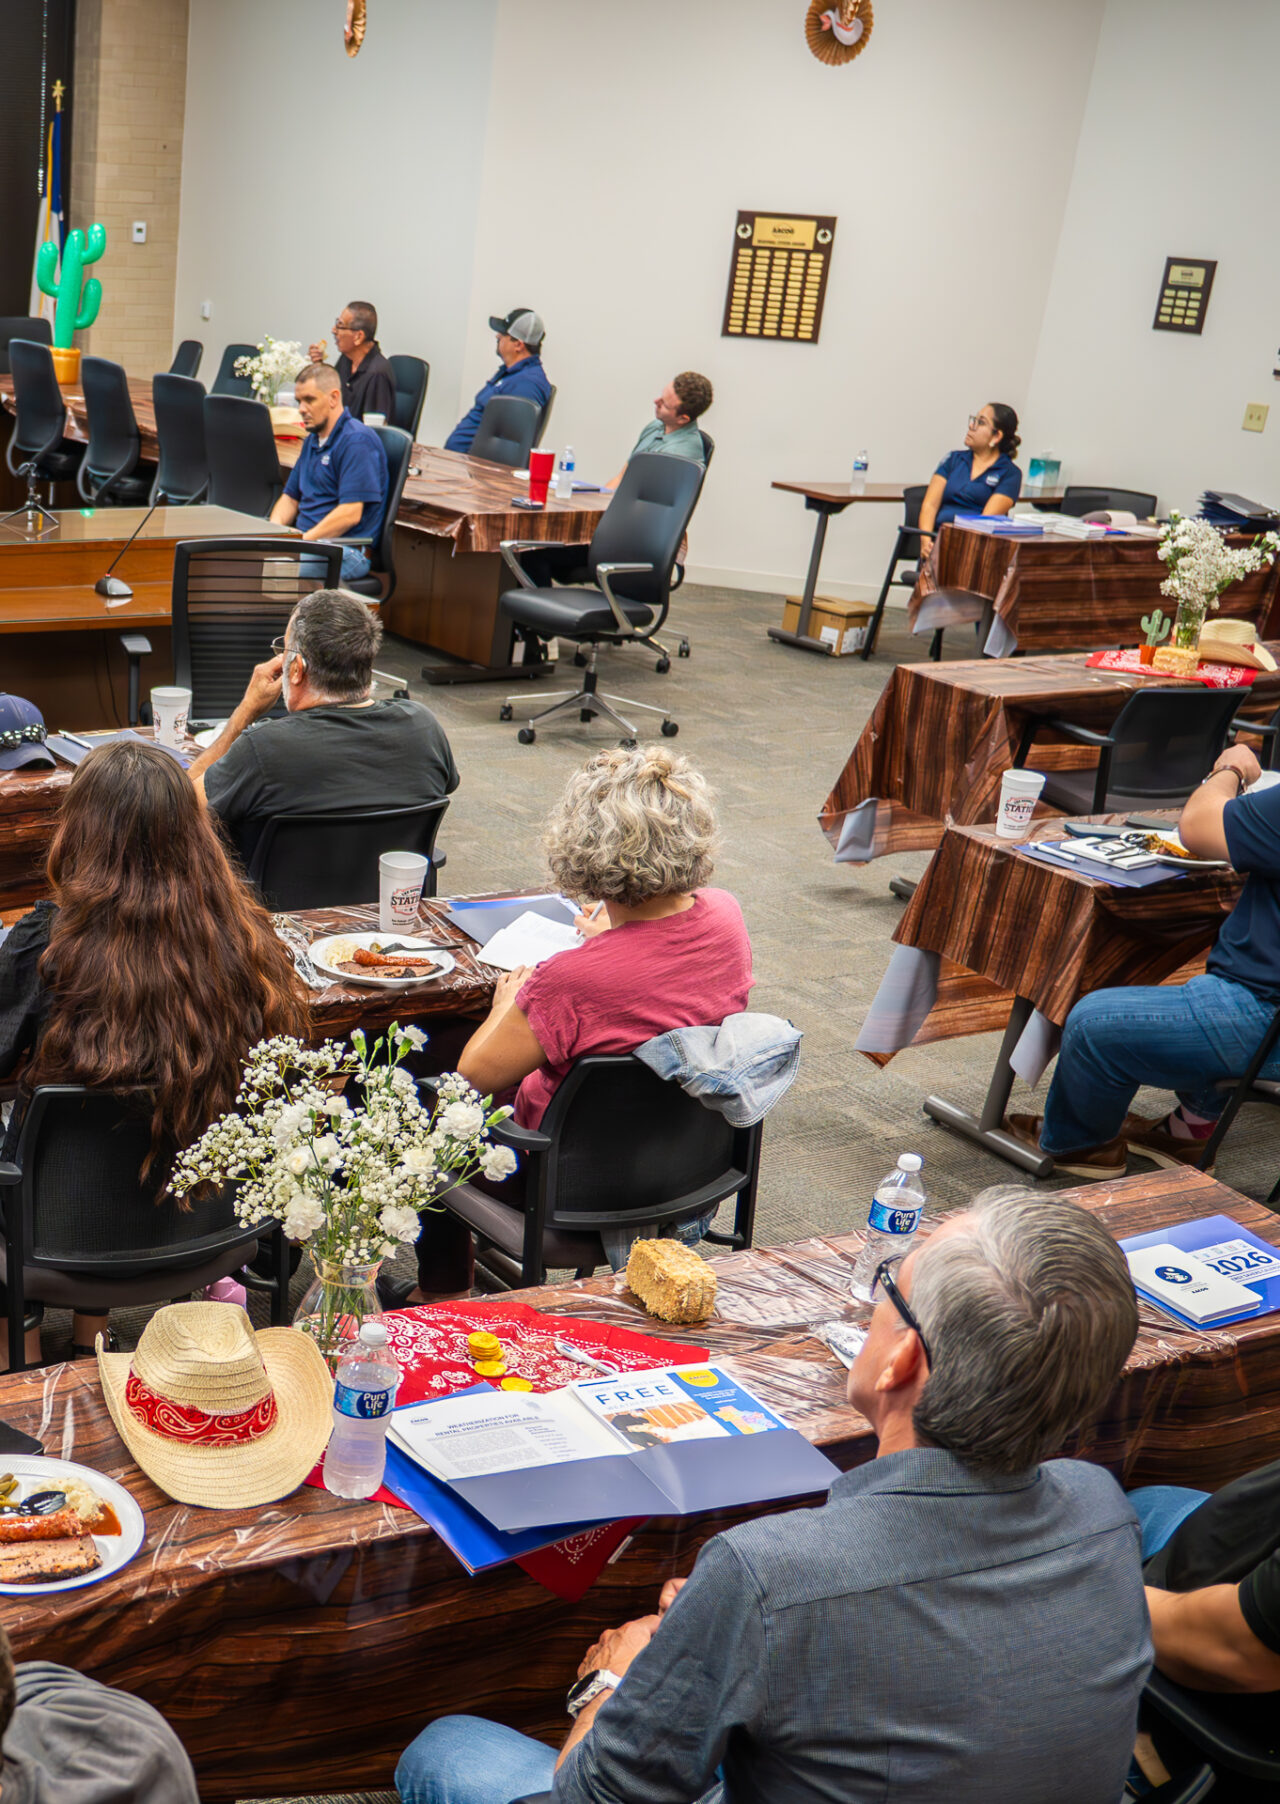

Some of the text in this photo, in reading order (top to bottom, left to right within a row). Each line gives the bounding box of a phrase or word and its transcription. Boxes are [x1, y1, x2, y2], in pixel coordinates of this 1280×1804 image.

[894, 1210, 914, 1219] Pure
[895, 1218, 911, 1227] Life
[1205, 1251, 1273, 1276] 2026
[363, 1392, 387, 1401] Pure
[605, 1385, 675, 1405] FREE
[365, 1400, 383, 1410] Life
